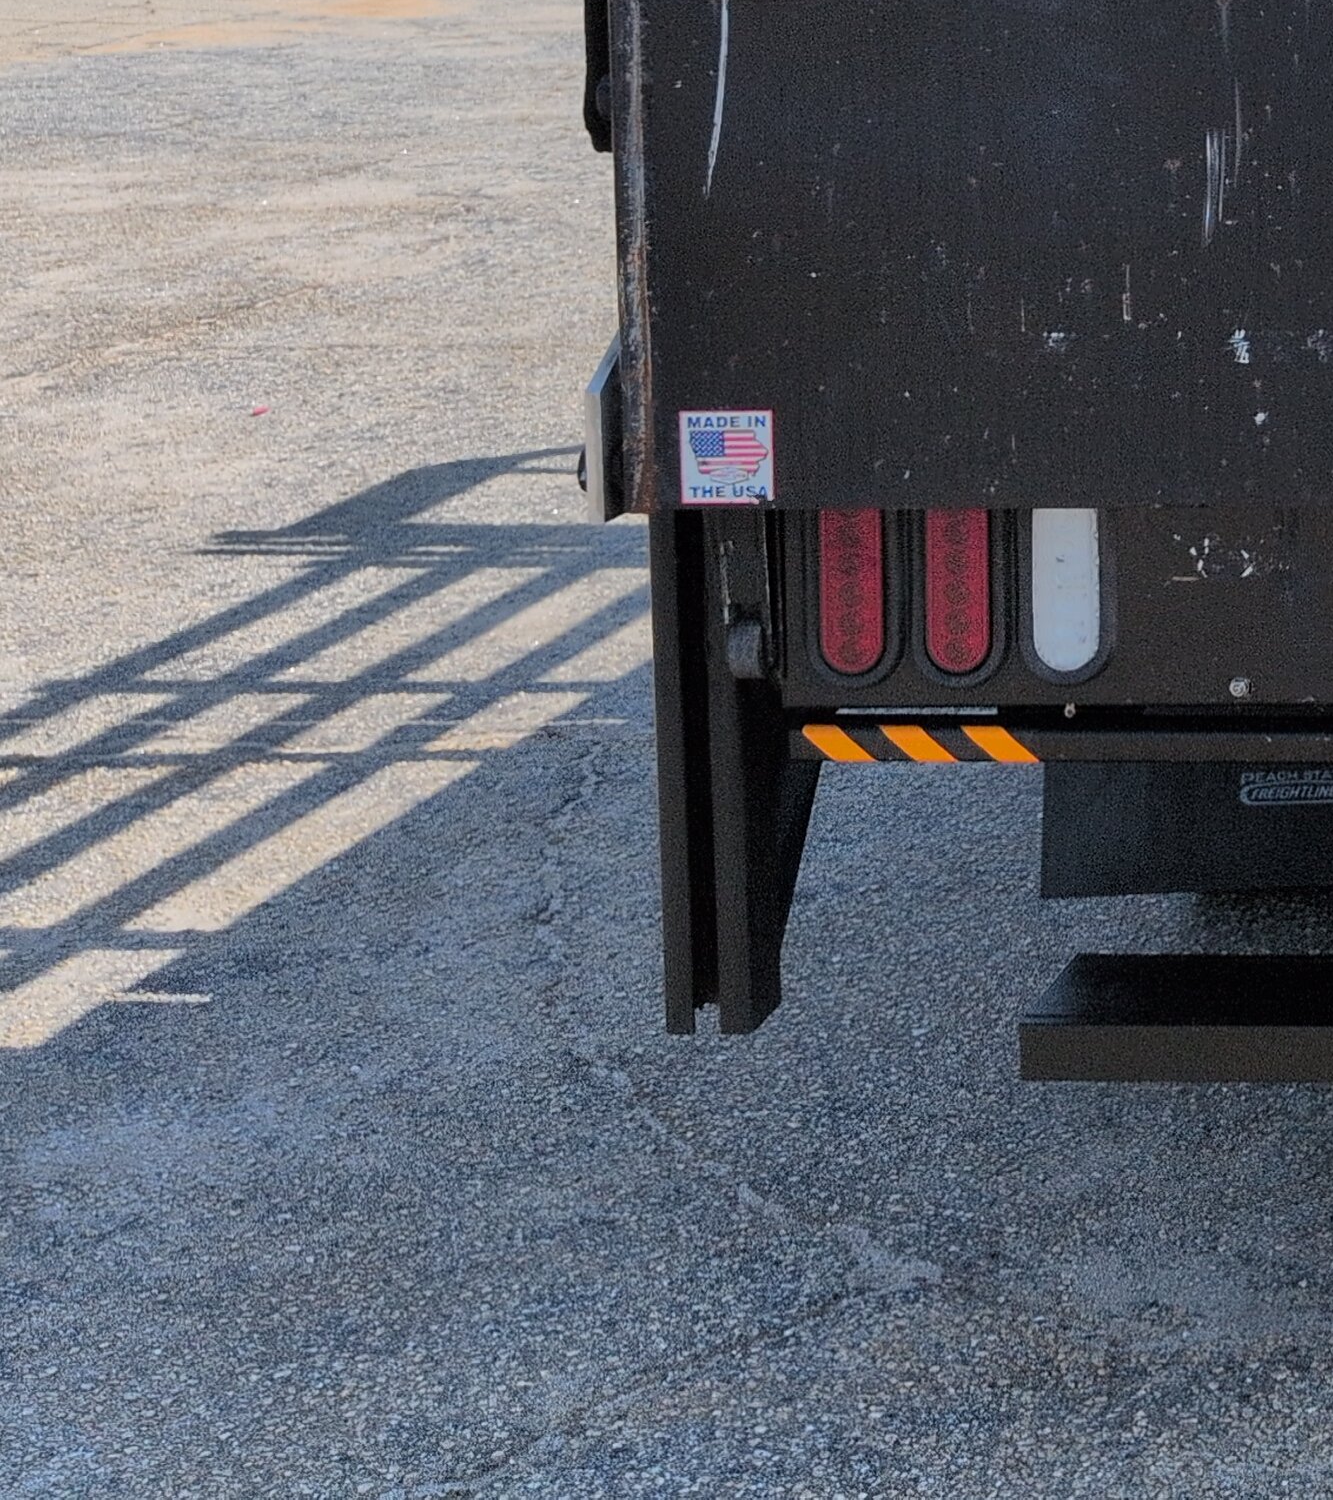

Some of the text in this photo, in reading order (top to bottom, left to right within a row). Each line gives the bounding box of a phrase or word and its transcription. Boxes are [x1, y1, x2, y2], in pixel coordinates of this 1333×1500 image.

[687, 416, 766, 428] MADE IN
[690, 485, 768, 498] THE USA
[1241, 771, 1298, 784] PEACH
